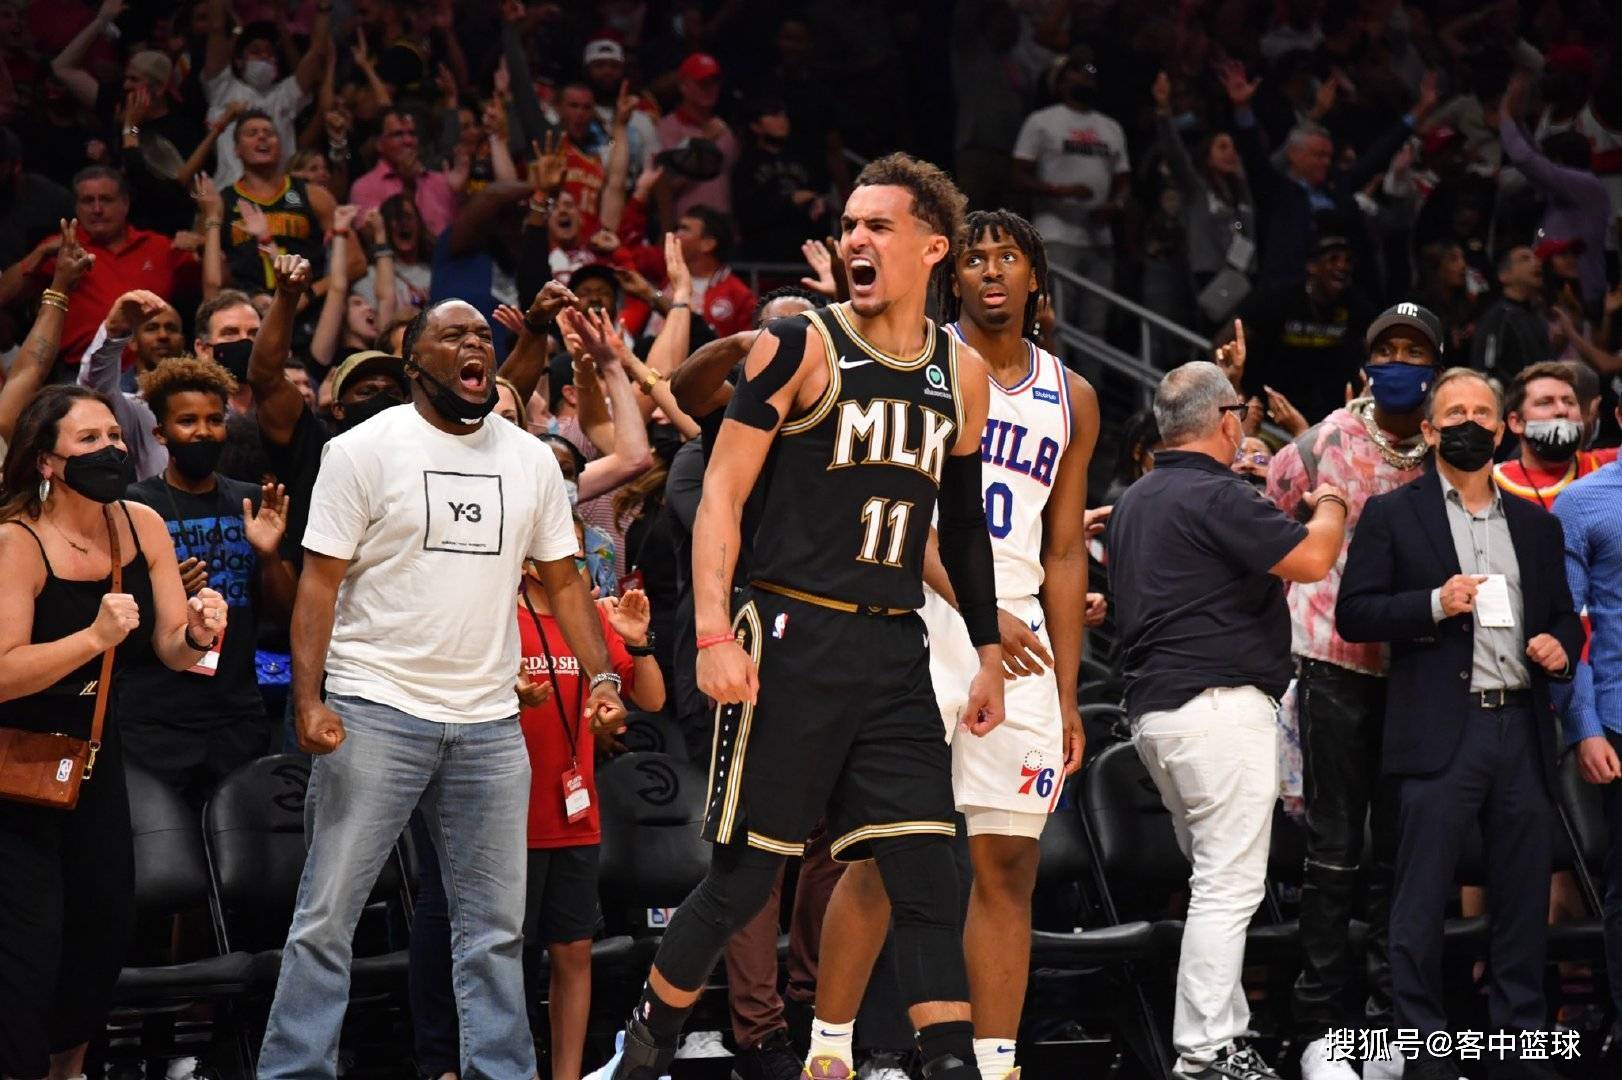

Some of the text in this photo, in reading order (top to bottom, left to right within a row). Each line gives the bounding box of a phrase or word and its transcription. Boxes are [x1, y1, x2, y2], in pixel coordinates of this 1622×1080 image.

[826, 398, 956, 490] MLK
[981, 418, 1060, 487] HILA
[447, 501, 482, 523] Y-3
[856, 496, 916, 568] 11
[986, 482, 1013, 539] 0
[1018, 764, 1055, 798] 76
